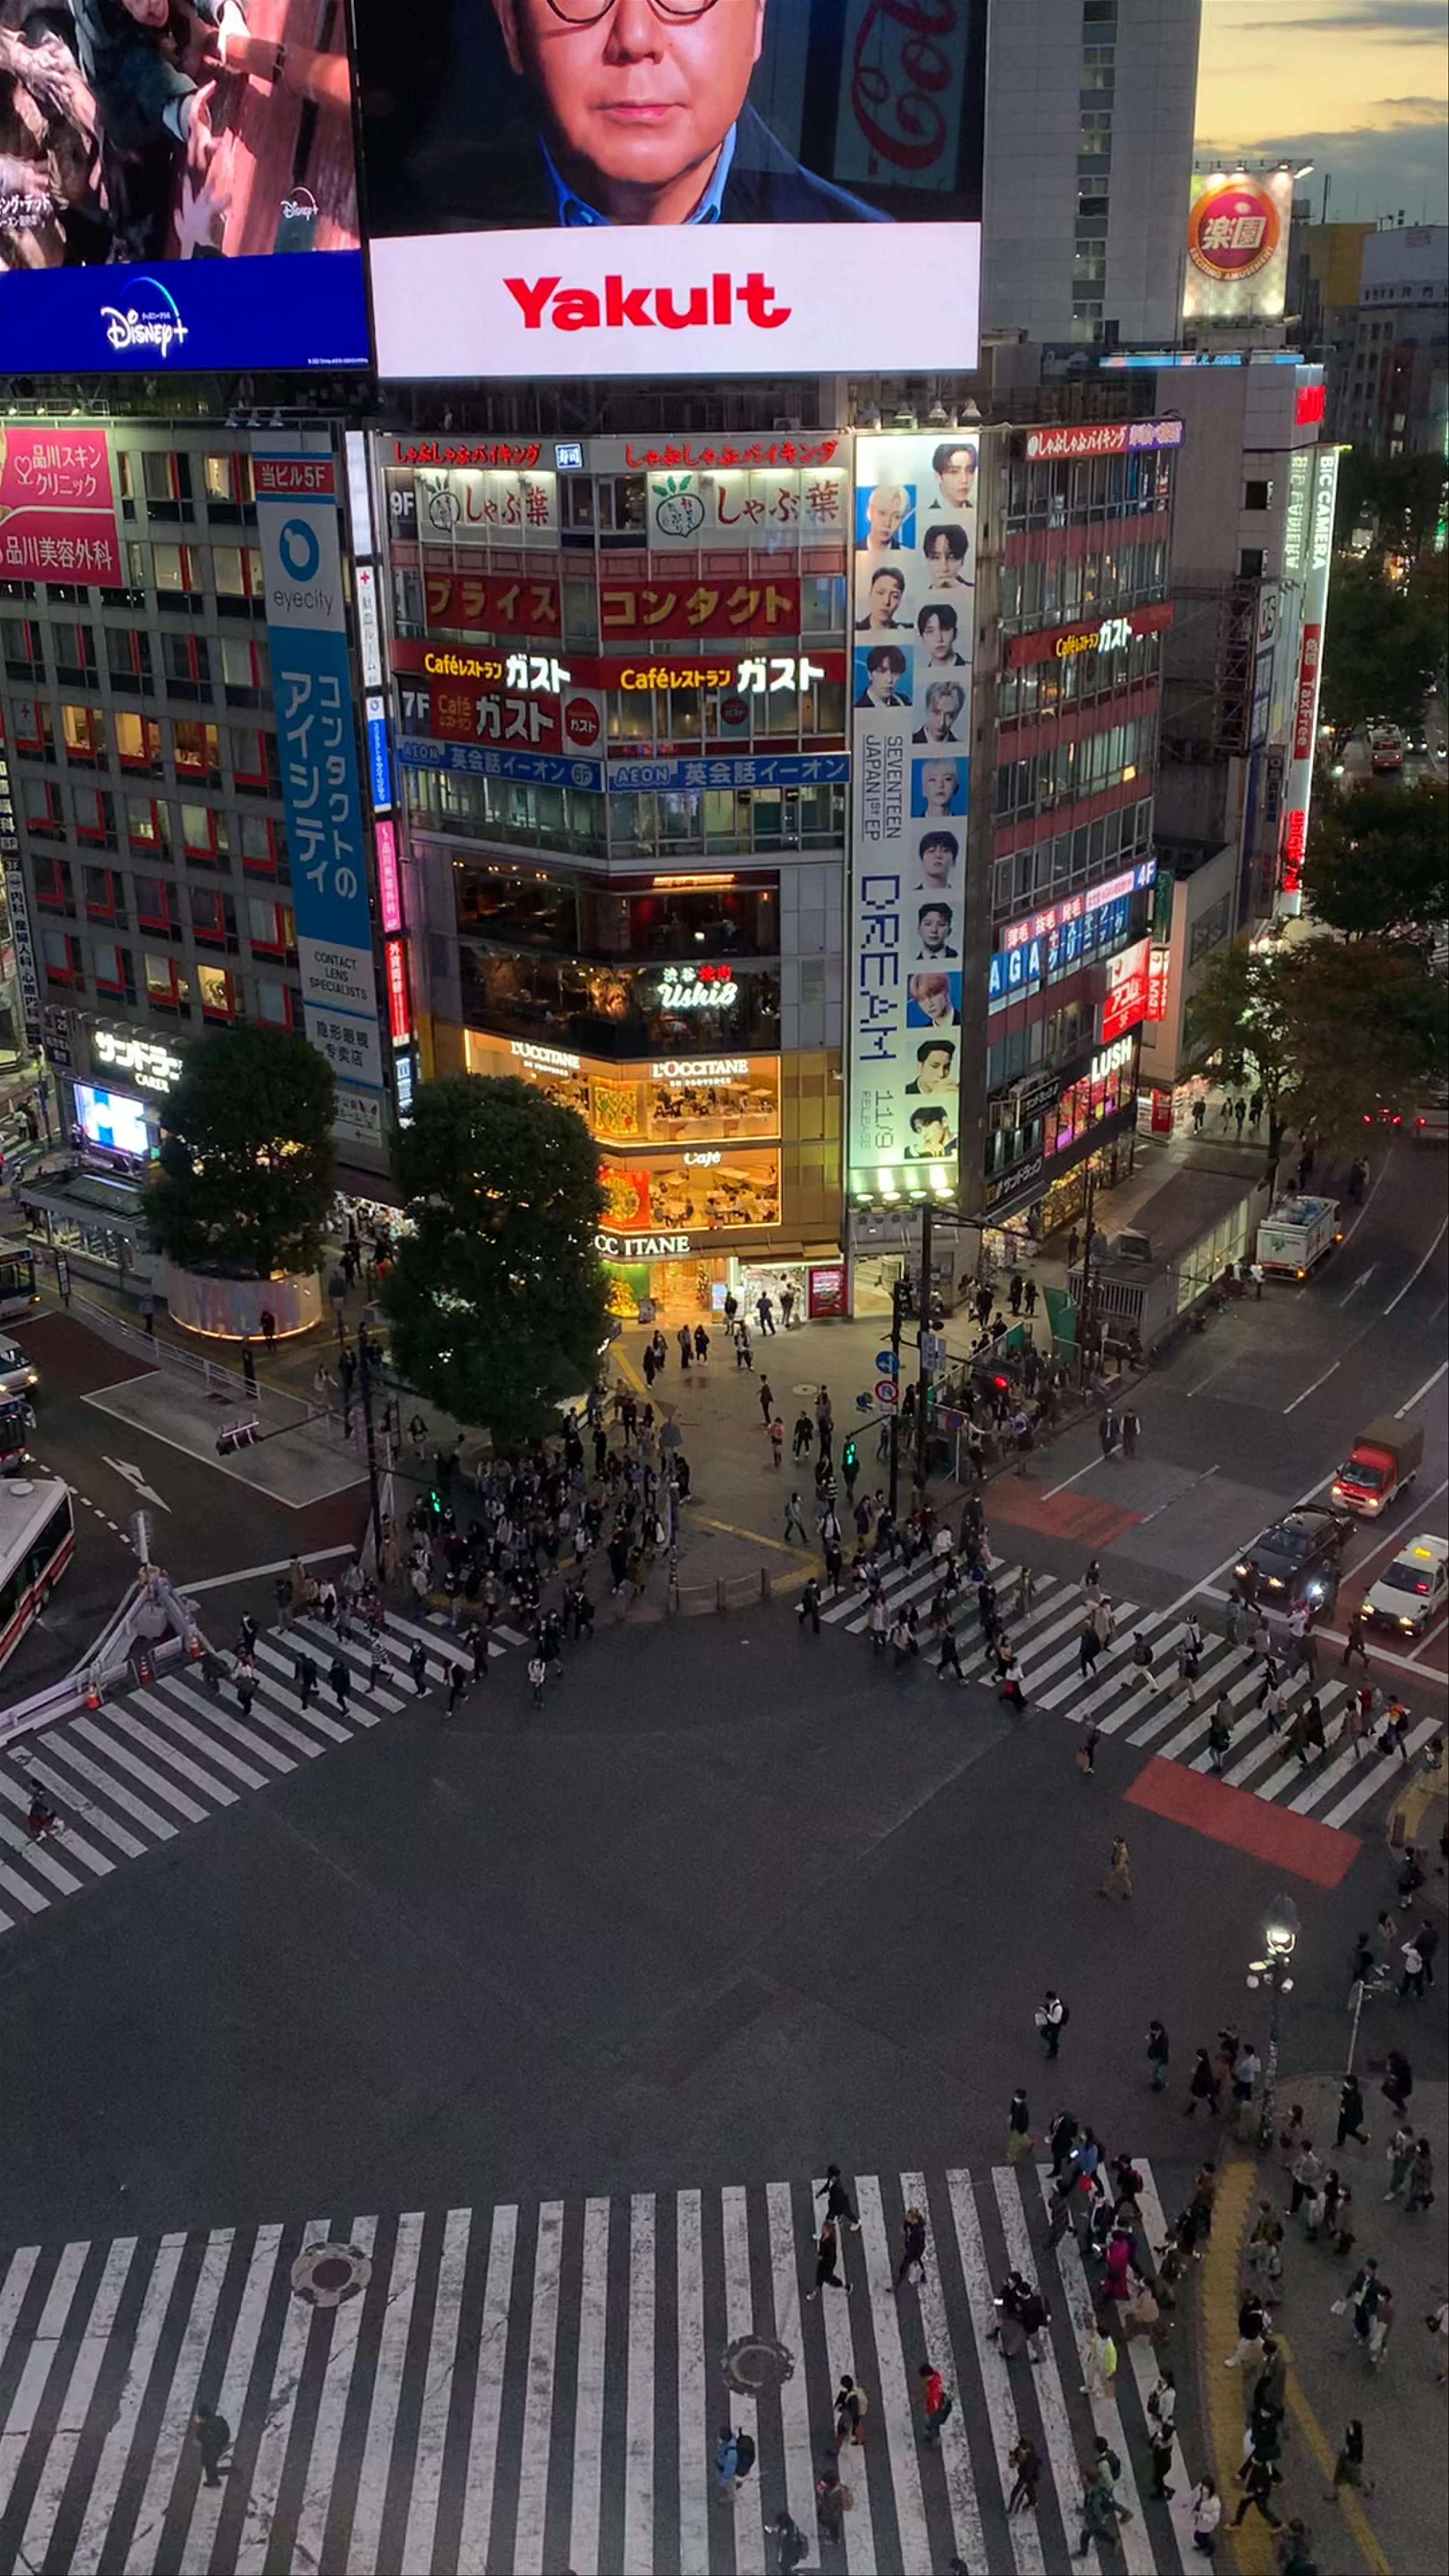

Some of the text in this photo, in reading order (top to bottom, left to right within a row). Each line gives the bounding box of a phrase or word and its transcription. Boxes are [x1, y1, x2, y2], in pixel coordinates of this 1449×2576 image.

[1201, 215, 1266, 249] 楽園
[503, 272, 792, 331] Yakult
[100, 306, 188, 358] Disney+
[32, 444, 101, 469] 品川スキン
[394, 440, 542, 467] しゃぶしゃぶバイキング
[625, 439, 838, 468] しゃぶしゃぶバイキング
[35, 473, 97, 497] クリニック
[718, 480, 839, 524] しゃぶ葉
[390, 491, 414, 515] 9F
[465, 485, 549, 527] しゃぶ葉
[1312, 456, 1334, 570] BIC CAMERA
[6, 536, 112, 571] 品川美容外科
[274, 589, 334, 616] eyecity
[603, 585, 792, 626] コンタクト
[1098, 617, 1132, 654] ガスト
[425, 653, 571, 694] Caféレストラン ガスト
[620, 657, 825, 693] Caféレストラン ガスト
[402, 691, 430, 718] 7F
[476, 694, 553, 742] ガスト
[1297, 679, 1314, 747] TaxFree
[571, 718, 597, 734] ガスト
[451, 747, 565, 780] 英会話イーオン
[616, 760, 845, 786] AEON 英会話イーオン
[865, 735, 881, 795] JAPAN
[281, 672, 328, 893] アイシティ
[318, 676, 358, 899] コンタクトの
[886, 736, 903, 839] SEVENTEEN
[864, 820, 880, 841] EP
[1137, 860, 1156, 887] 4F
[314, 950, 356, 970] CONTACT
[325, 966, 349, 982] LENS
[859, 875, 900, 1060] DREAM
[989, 941, 1040, 994] AGA
[310, 977, 368, 1000] SPECIALISTS
[657, 981, 738, 1008] Ushi8
[653, 1060, 749, 1078] L'OCCITANE
[1091, 1035, 1132, 1084] LUSH
[684, 1150, 721, 1166] Café
